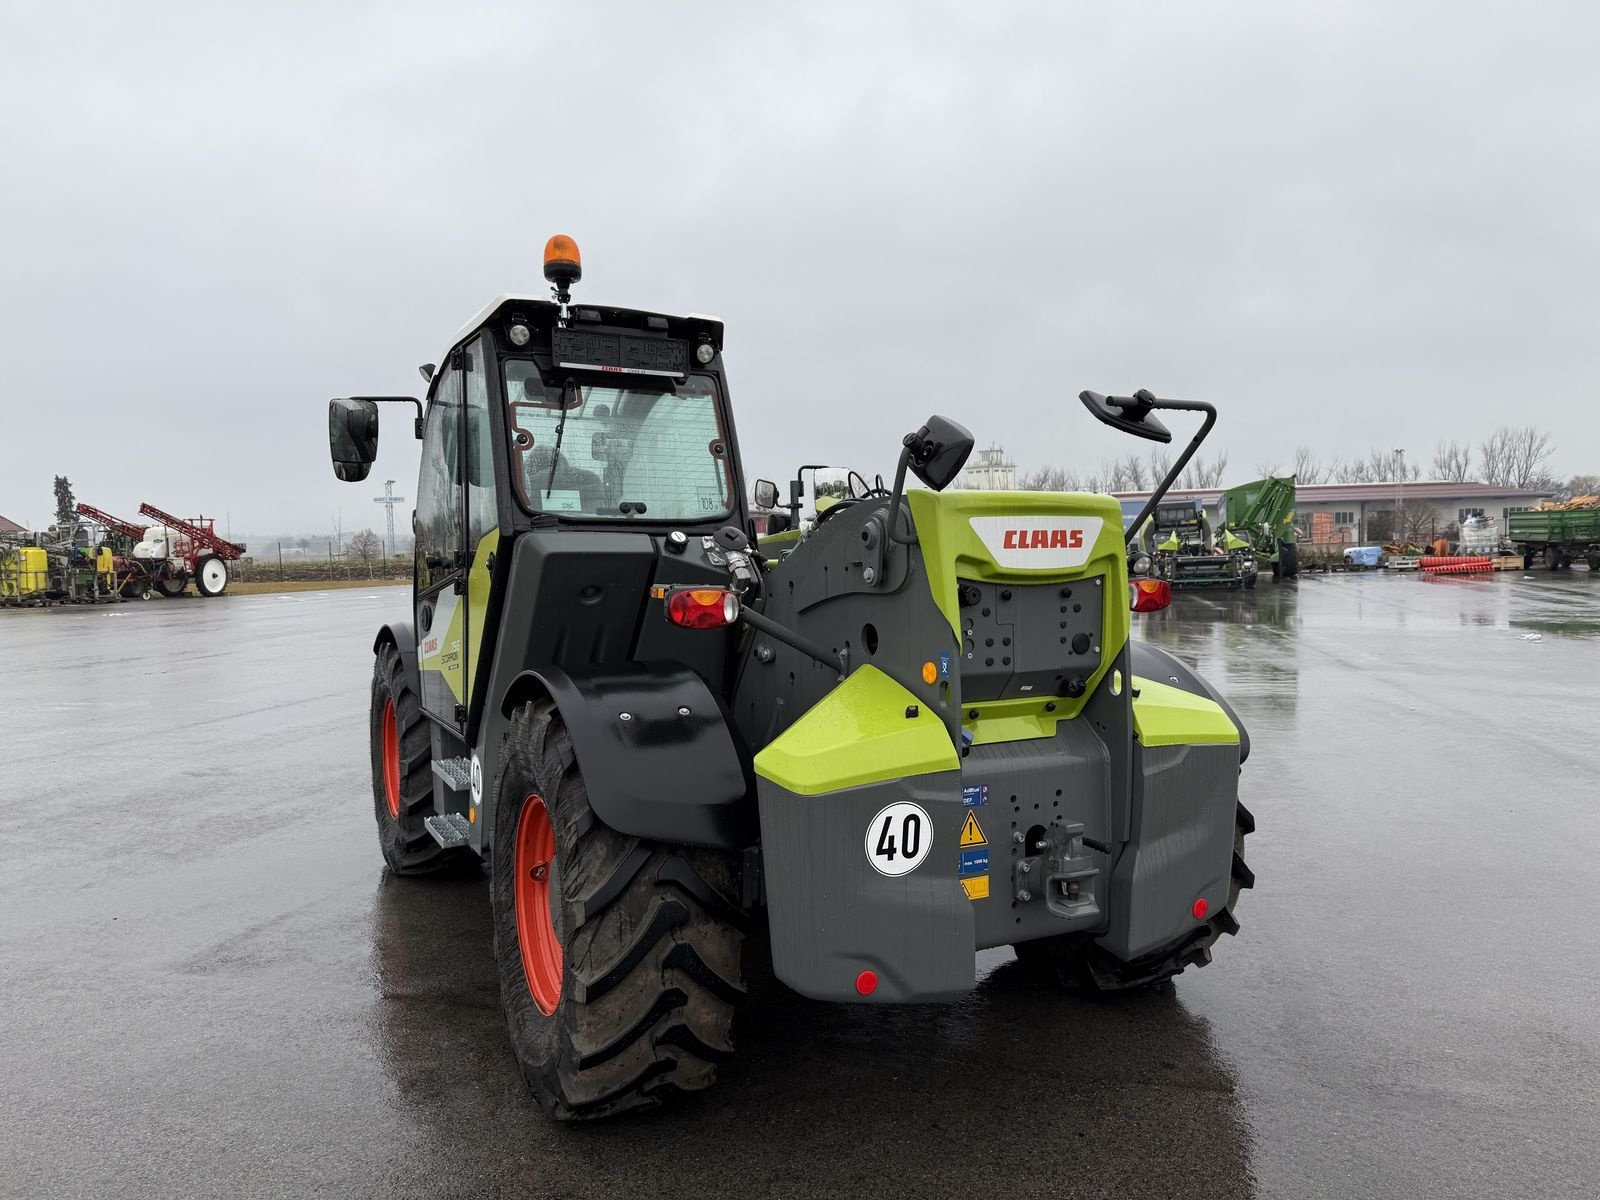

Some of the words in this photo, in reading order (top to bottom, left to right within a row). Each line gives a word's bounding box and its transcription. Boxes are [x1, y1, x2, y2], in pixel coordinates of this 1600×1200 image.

[1003, 530, 1083, 549] CLAAS
[424, 638, 438, 654] CLAAS
[876, 813, 921, 861] 40
